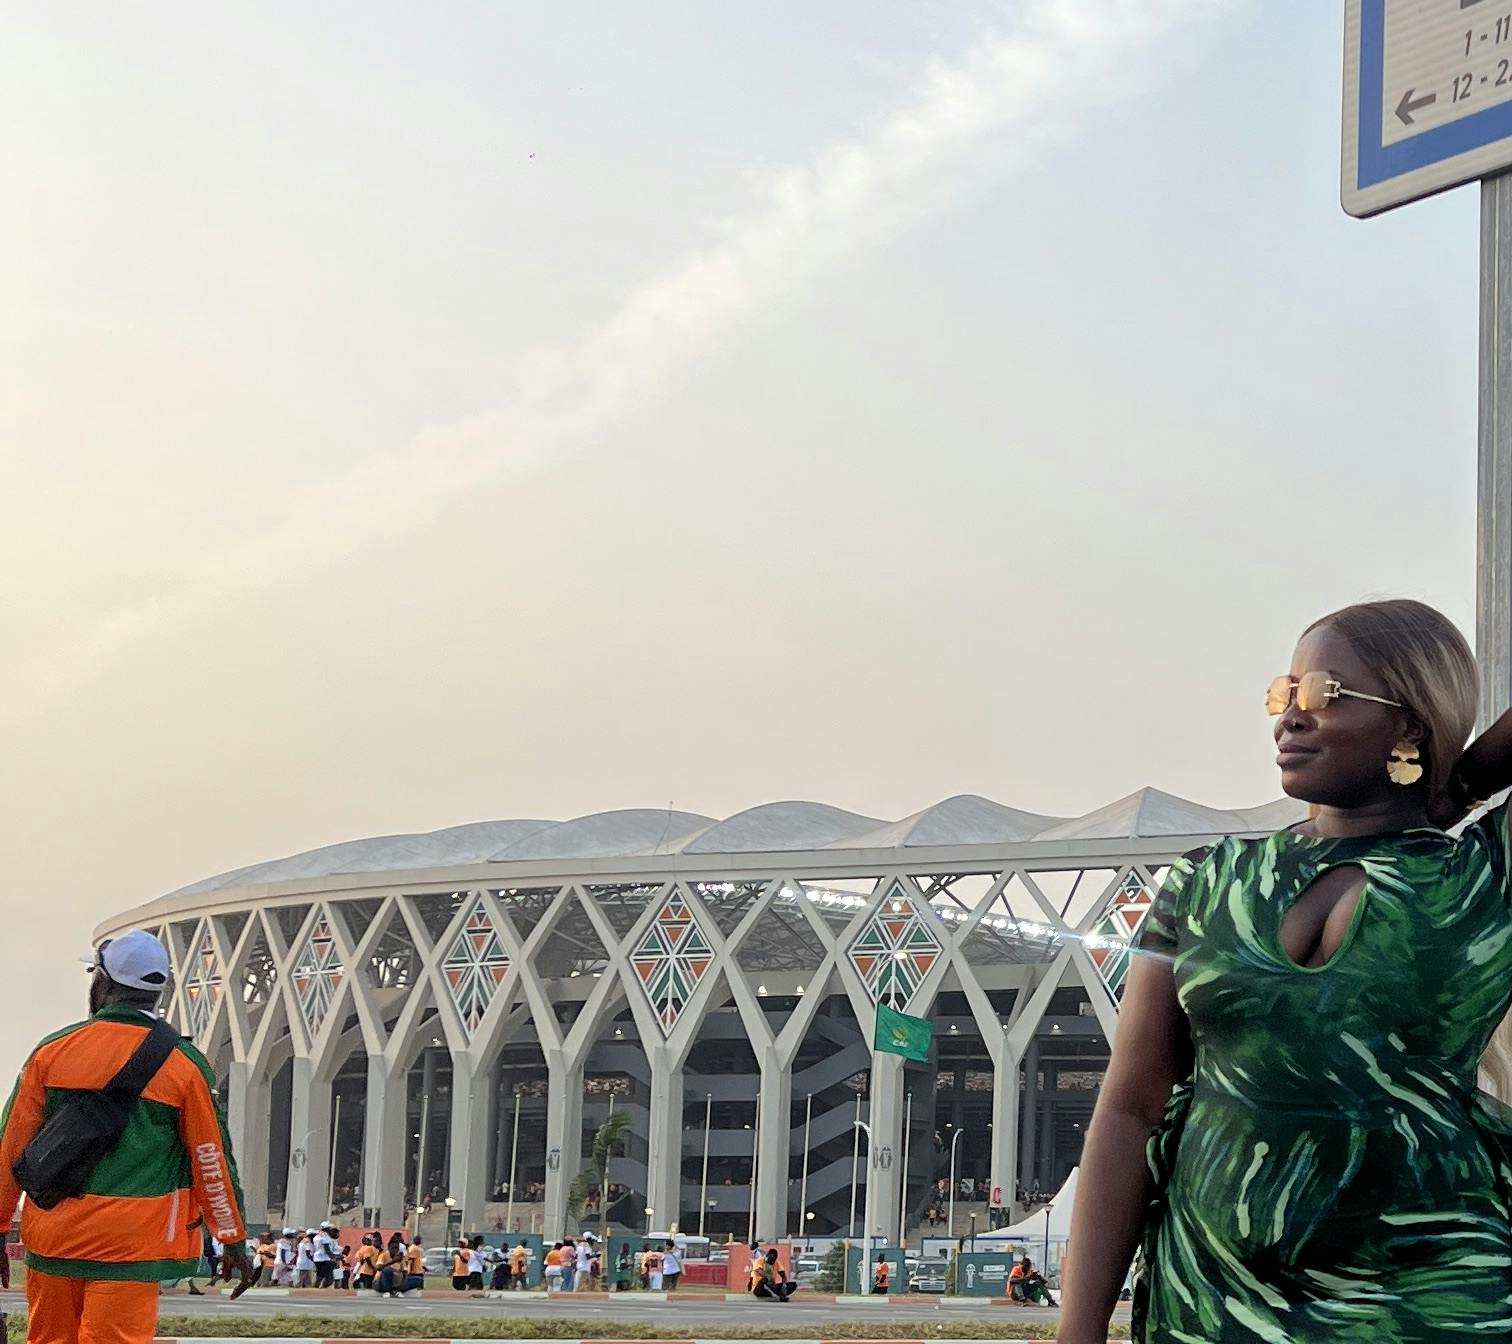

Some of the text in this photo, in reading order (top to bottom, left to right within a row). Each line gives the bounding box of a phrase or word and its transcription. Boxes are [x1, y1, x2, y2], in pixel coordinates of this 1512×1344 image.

[1465, 29, 1472, 56] 1
[1496, 14, 1511, 45] 11
[1452, 72, 1473, 104] 12
